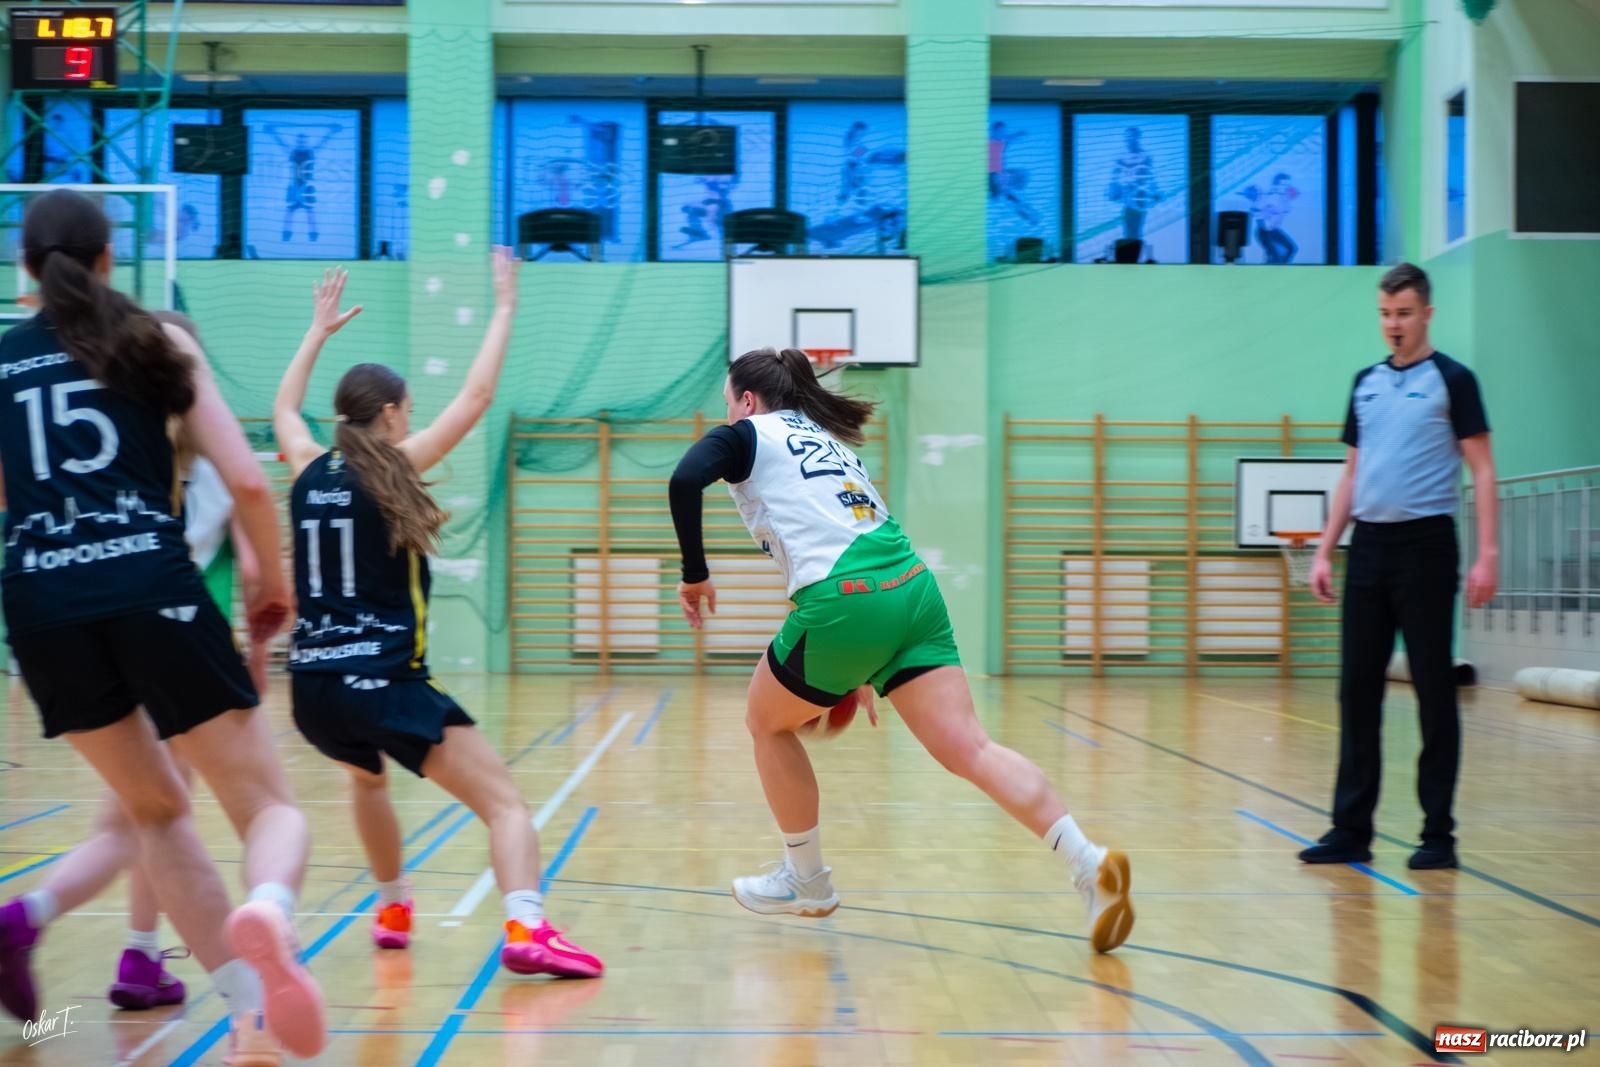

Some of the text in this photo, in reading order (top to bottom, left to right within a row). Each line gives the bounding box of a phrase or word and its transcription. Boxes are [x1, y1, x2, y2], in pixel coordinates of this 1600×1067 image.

[64, 47, 93, 80] 9
[13, 378, 120, 481] 15
[300, 518, 356, 598] 11
